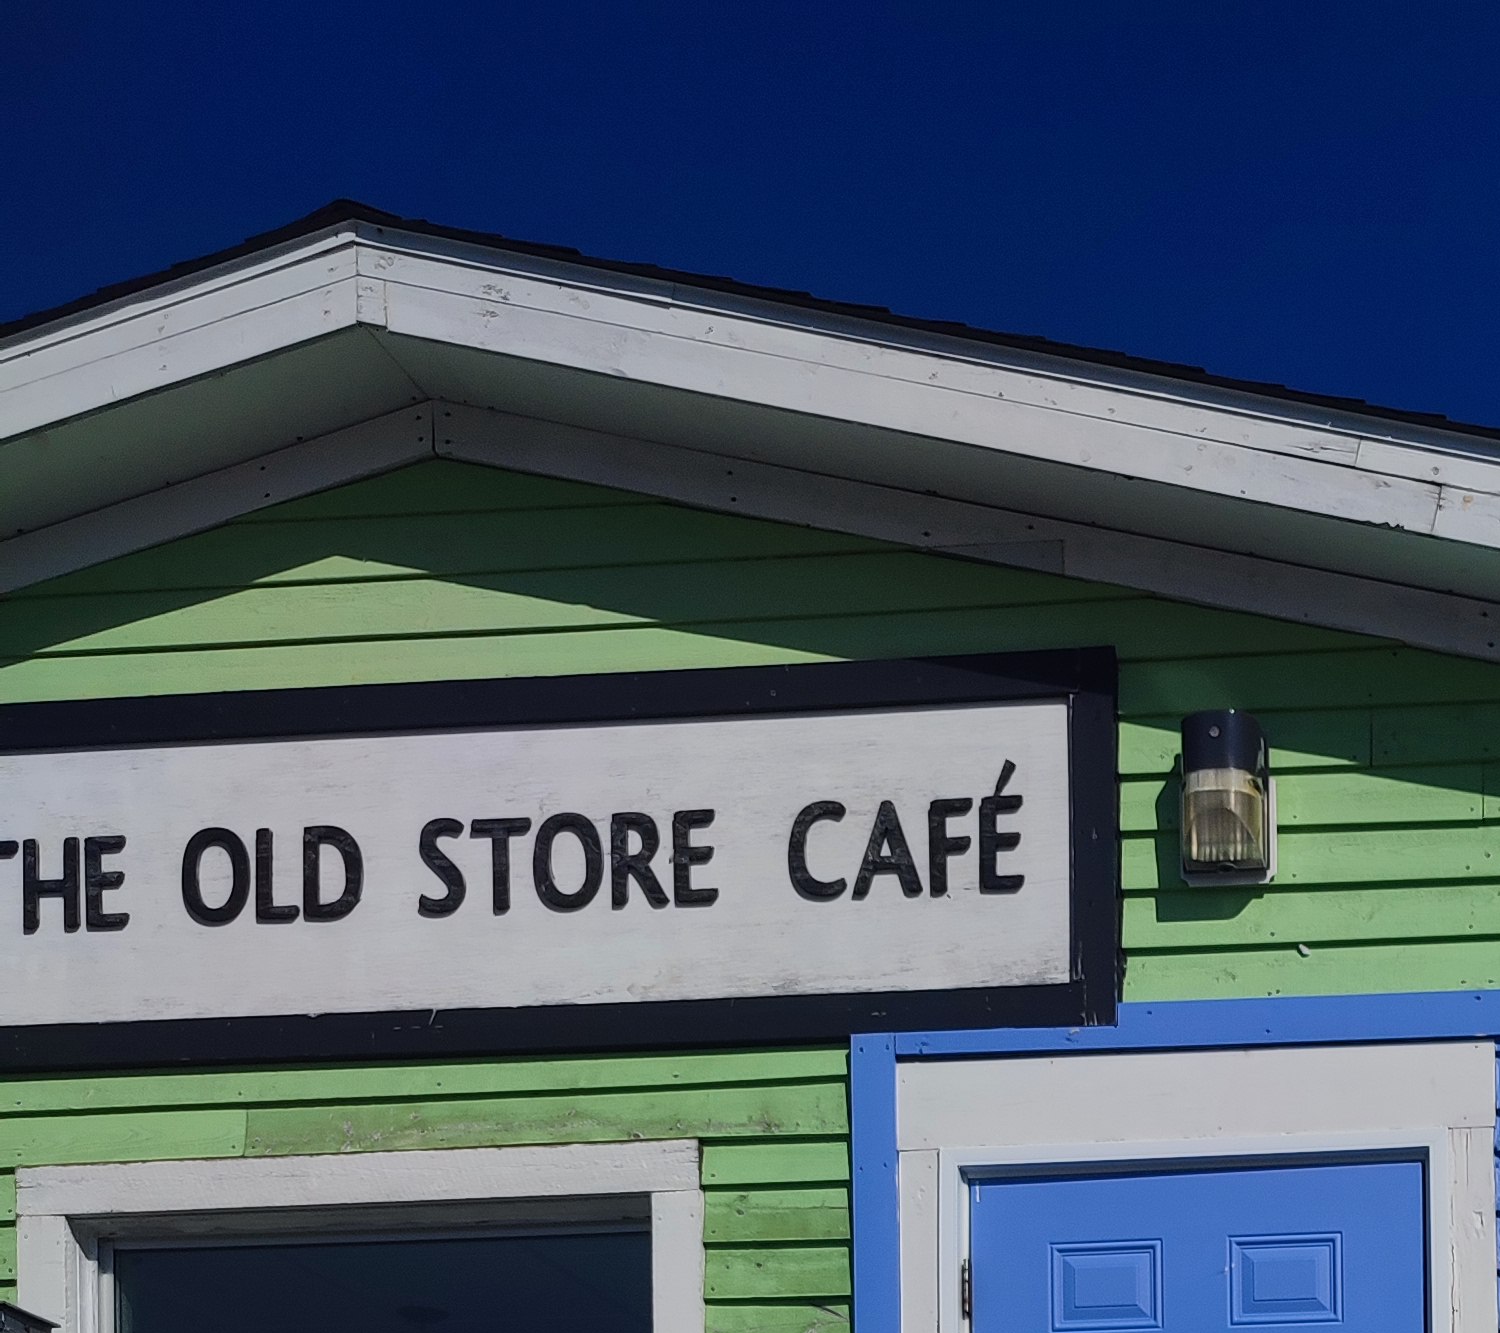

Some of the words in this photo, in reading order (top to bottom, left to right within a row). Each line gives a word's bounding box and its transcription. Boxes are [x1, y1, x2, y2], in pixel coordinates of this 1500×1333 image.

[182, 825, 364, 928] OLD
[417, 808, 720, 918] STORE
[787, 759, 1025, 902] CAFÉ
